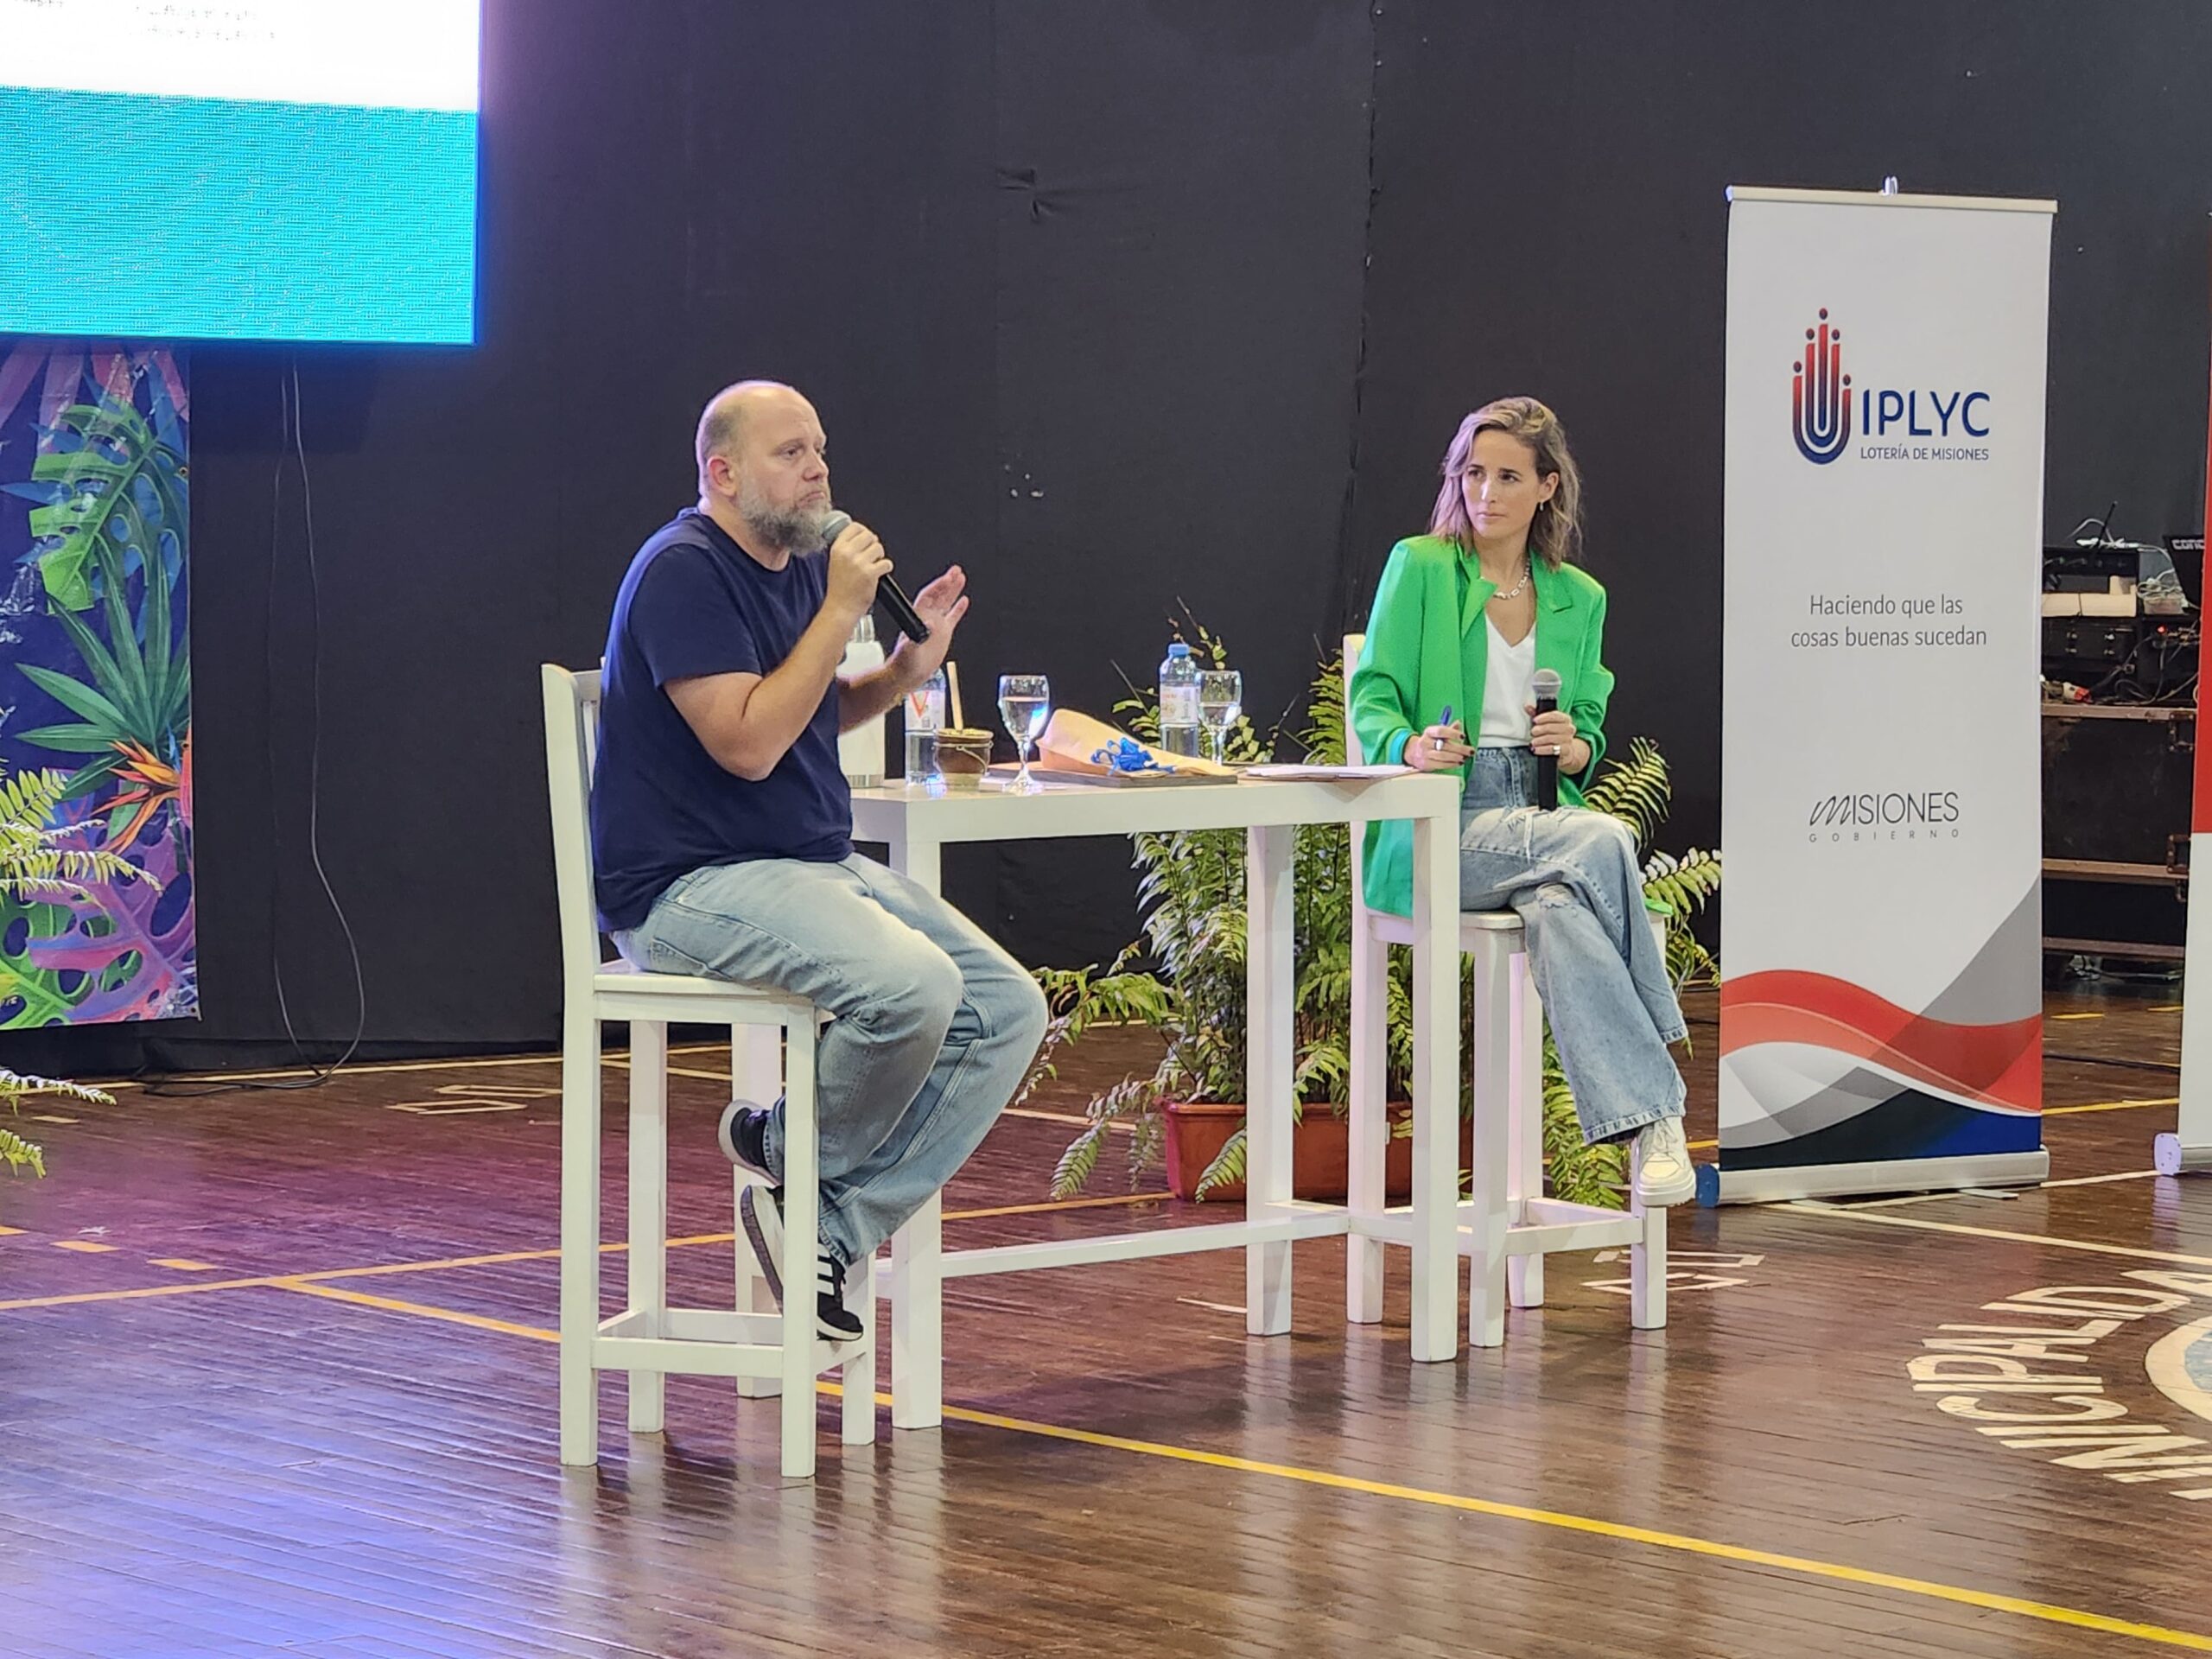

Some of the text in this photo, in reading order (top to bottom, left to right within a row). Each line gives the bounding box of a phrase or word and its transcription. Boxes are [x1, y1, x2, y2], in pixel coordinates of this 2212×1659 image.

[1862, 388, 1991, 438] IPLYC
[1860, 442, 1989, 461] LOTERÍA DE MISIONES
[1810, 593, 1963, 620] Haciendo que las
[1790, 624, 1987, 648] cosas buenas sucedan
[1808, 791, 1960, 827] MISIONES
[1808, 828, 1959, 843] GOBIERNO
